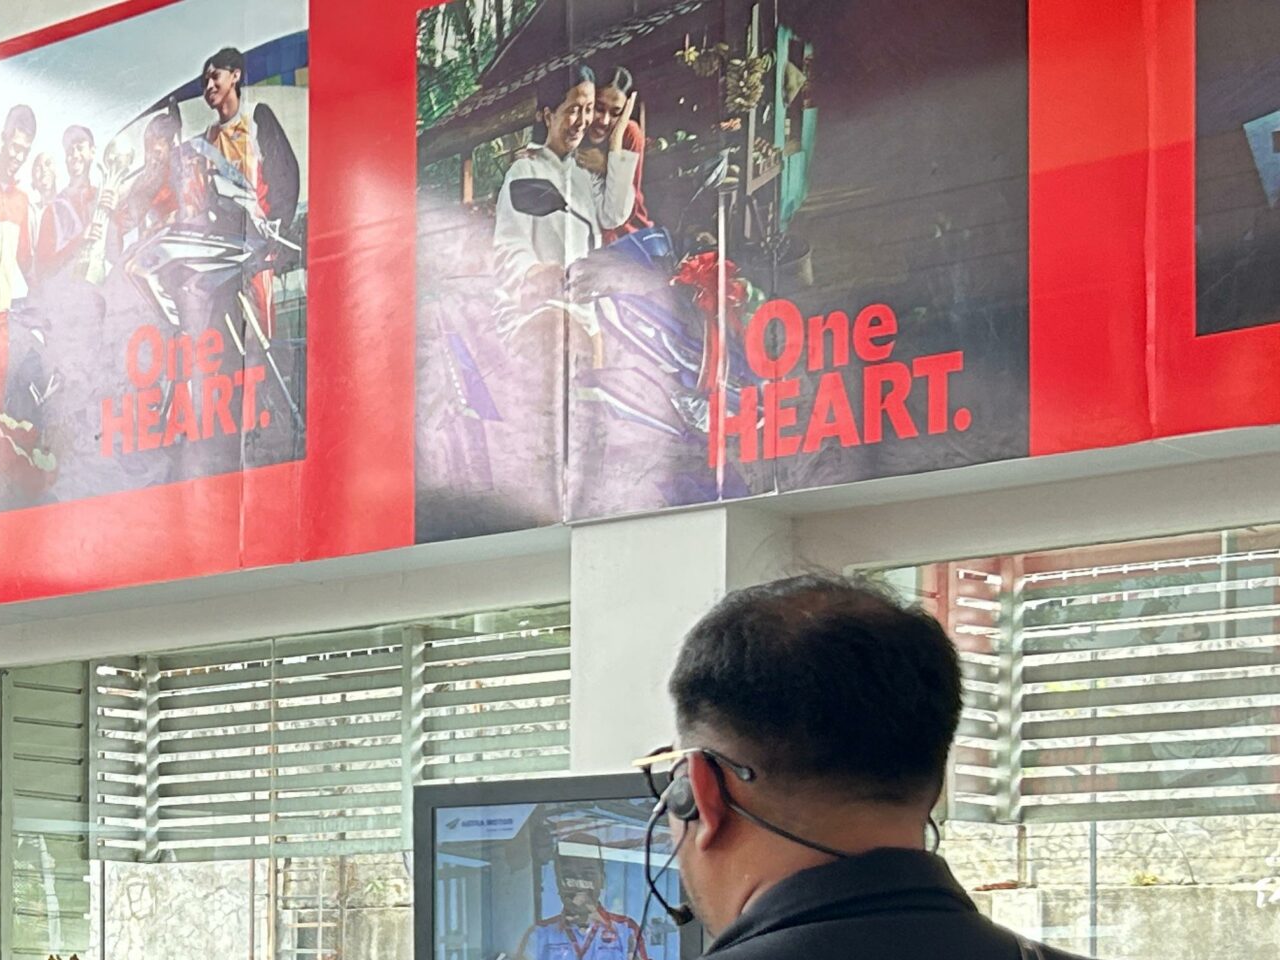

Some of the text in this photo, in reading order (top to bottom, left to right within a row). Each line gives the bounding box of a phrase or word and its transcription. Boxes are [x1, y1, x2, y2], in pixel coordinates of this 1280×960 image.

[127, 324, 224, 388] One
[745, 298, 898, 379] One
[101, 366, 270, 457] HEART.
[708, 350, 971, 468] HEART.
